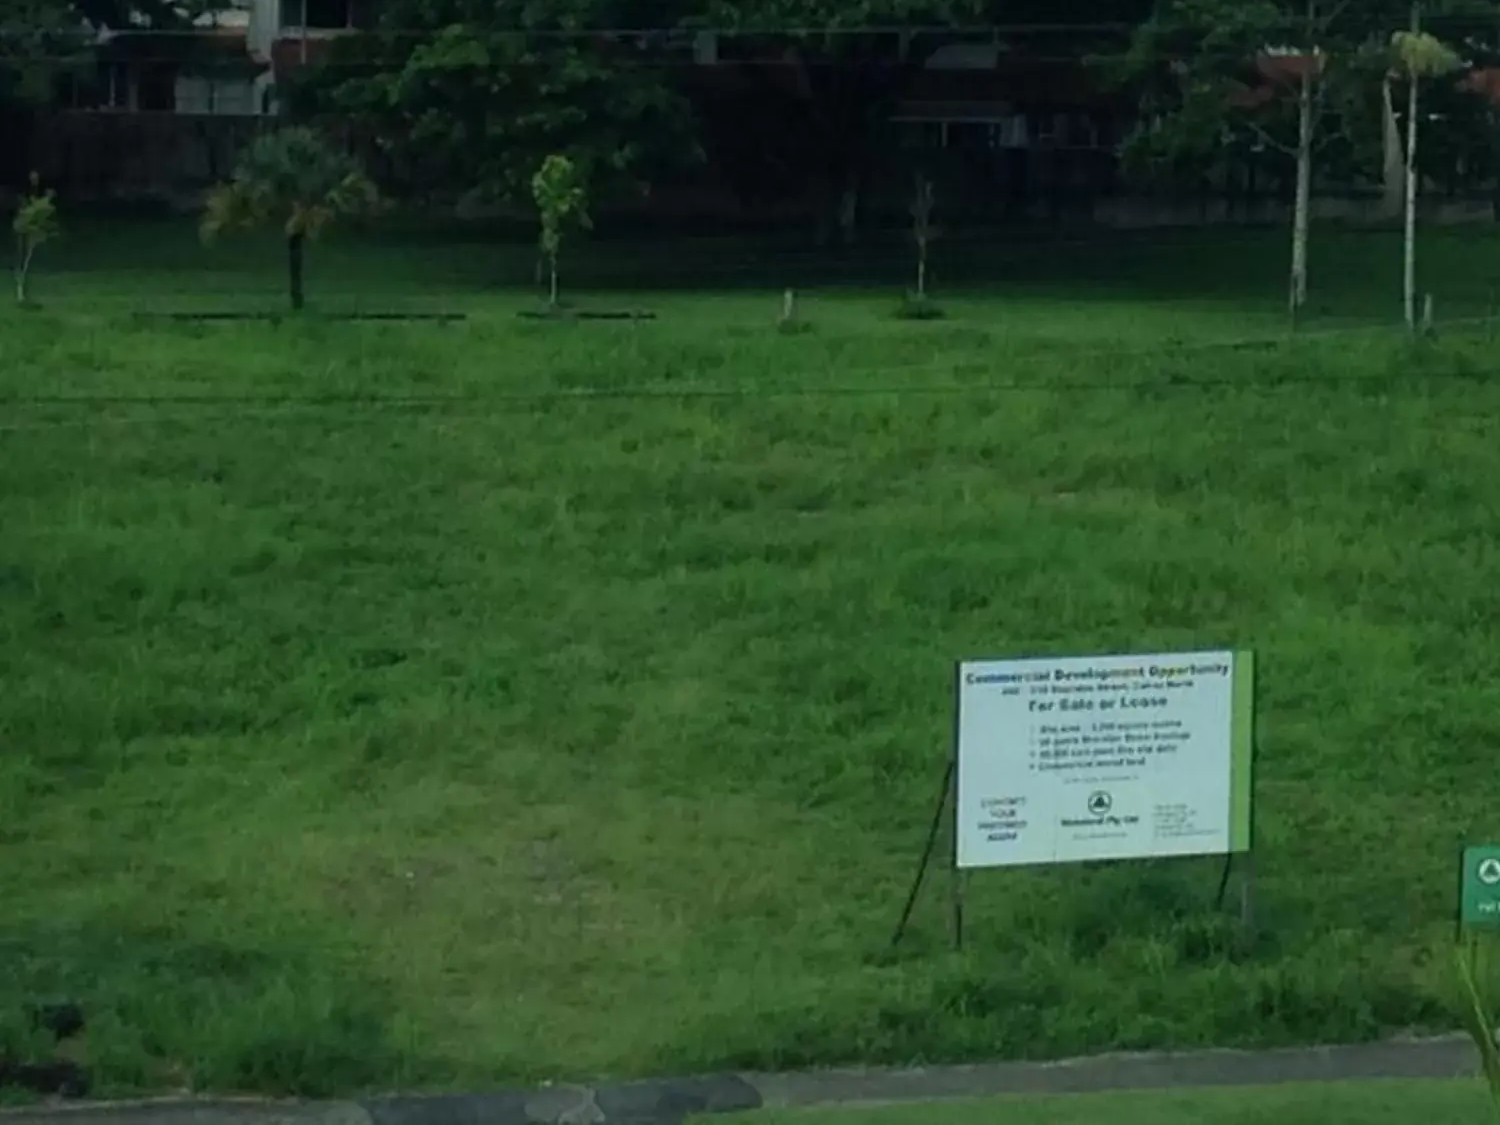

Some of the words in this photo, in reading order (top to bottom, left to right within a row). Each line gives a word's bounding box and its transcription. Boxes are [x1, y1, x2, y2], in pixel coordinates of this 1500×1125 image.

[1054, 666, 1145, 682] Development
[1149, 663, 1229, 679] Opportunity
[1028, 700, 1054, 712] For
[1059, 698, 1094, 712] Sale
[1099, 698, 1115, 711] or
[1120, 696, 1168, 710] Lease
